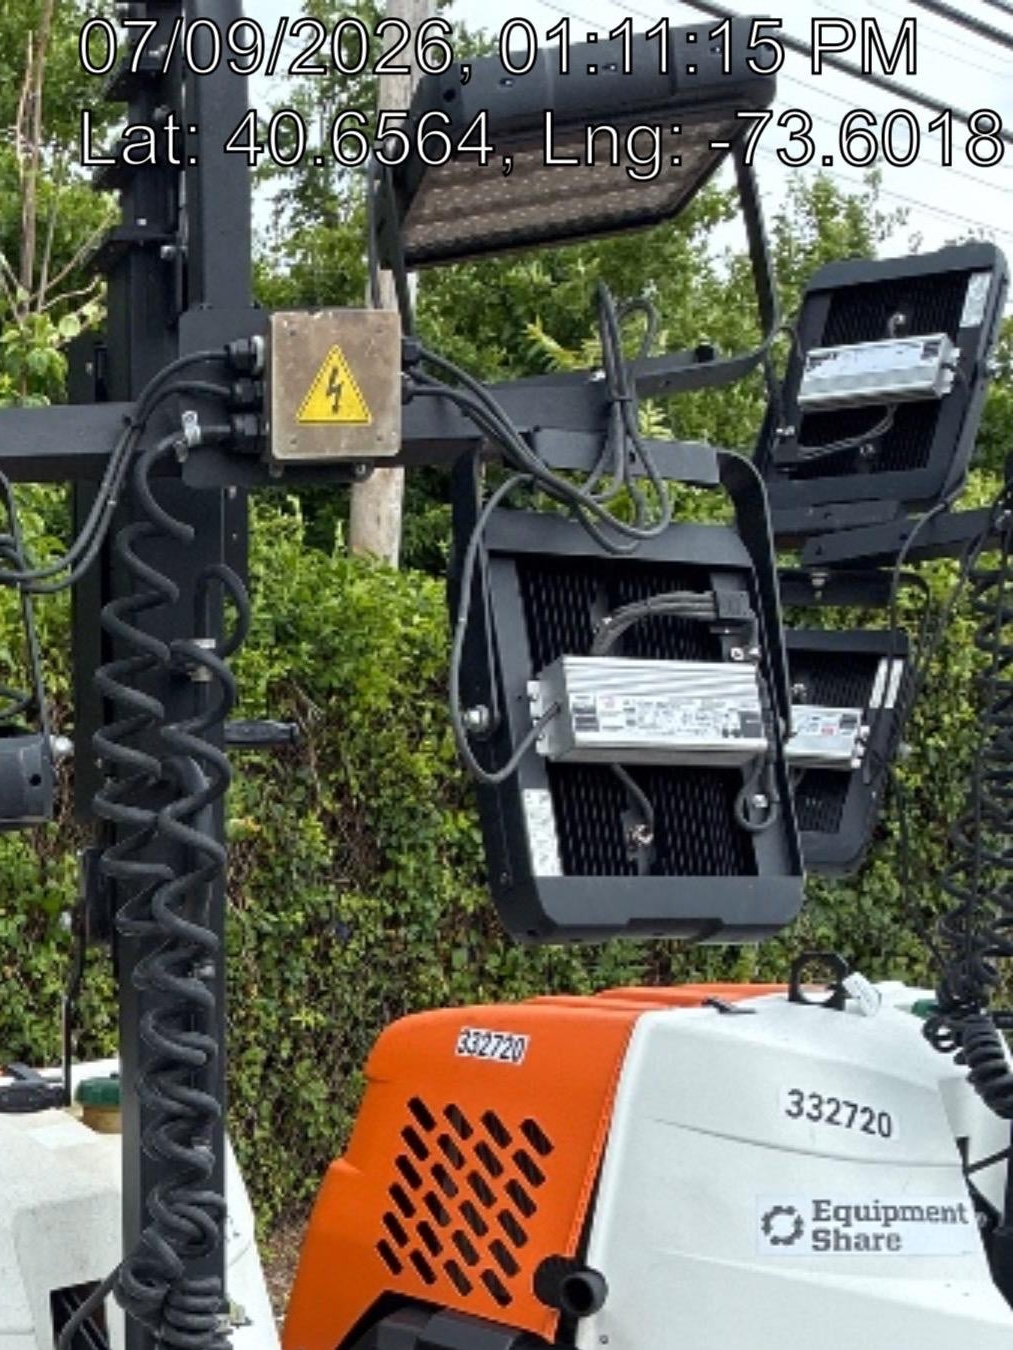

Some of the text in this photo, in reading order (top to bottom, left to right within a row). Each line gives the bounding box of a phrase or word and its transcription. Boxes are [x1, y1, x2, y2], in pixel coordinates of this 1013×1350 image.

[457, 1029, 526, 1063] 332720
[785, 1088, 893, 1138] 332720
[811, 1199, 970, 1227] Equipment
[811, 1228, 902, 1252] Share
